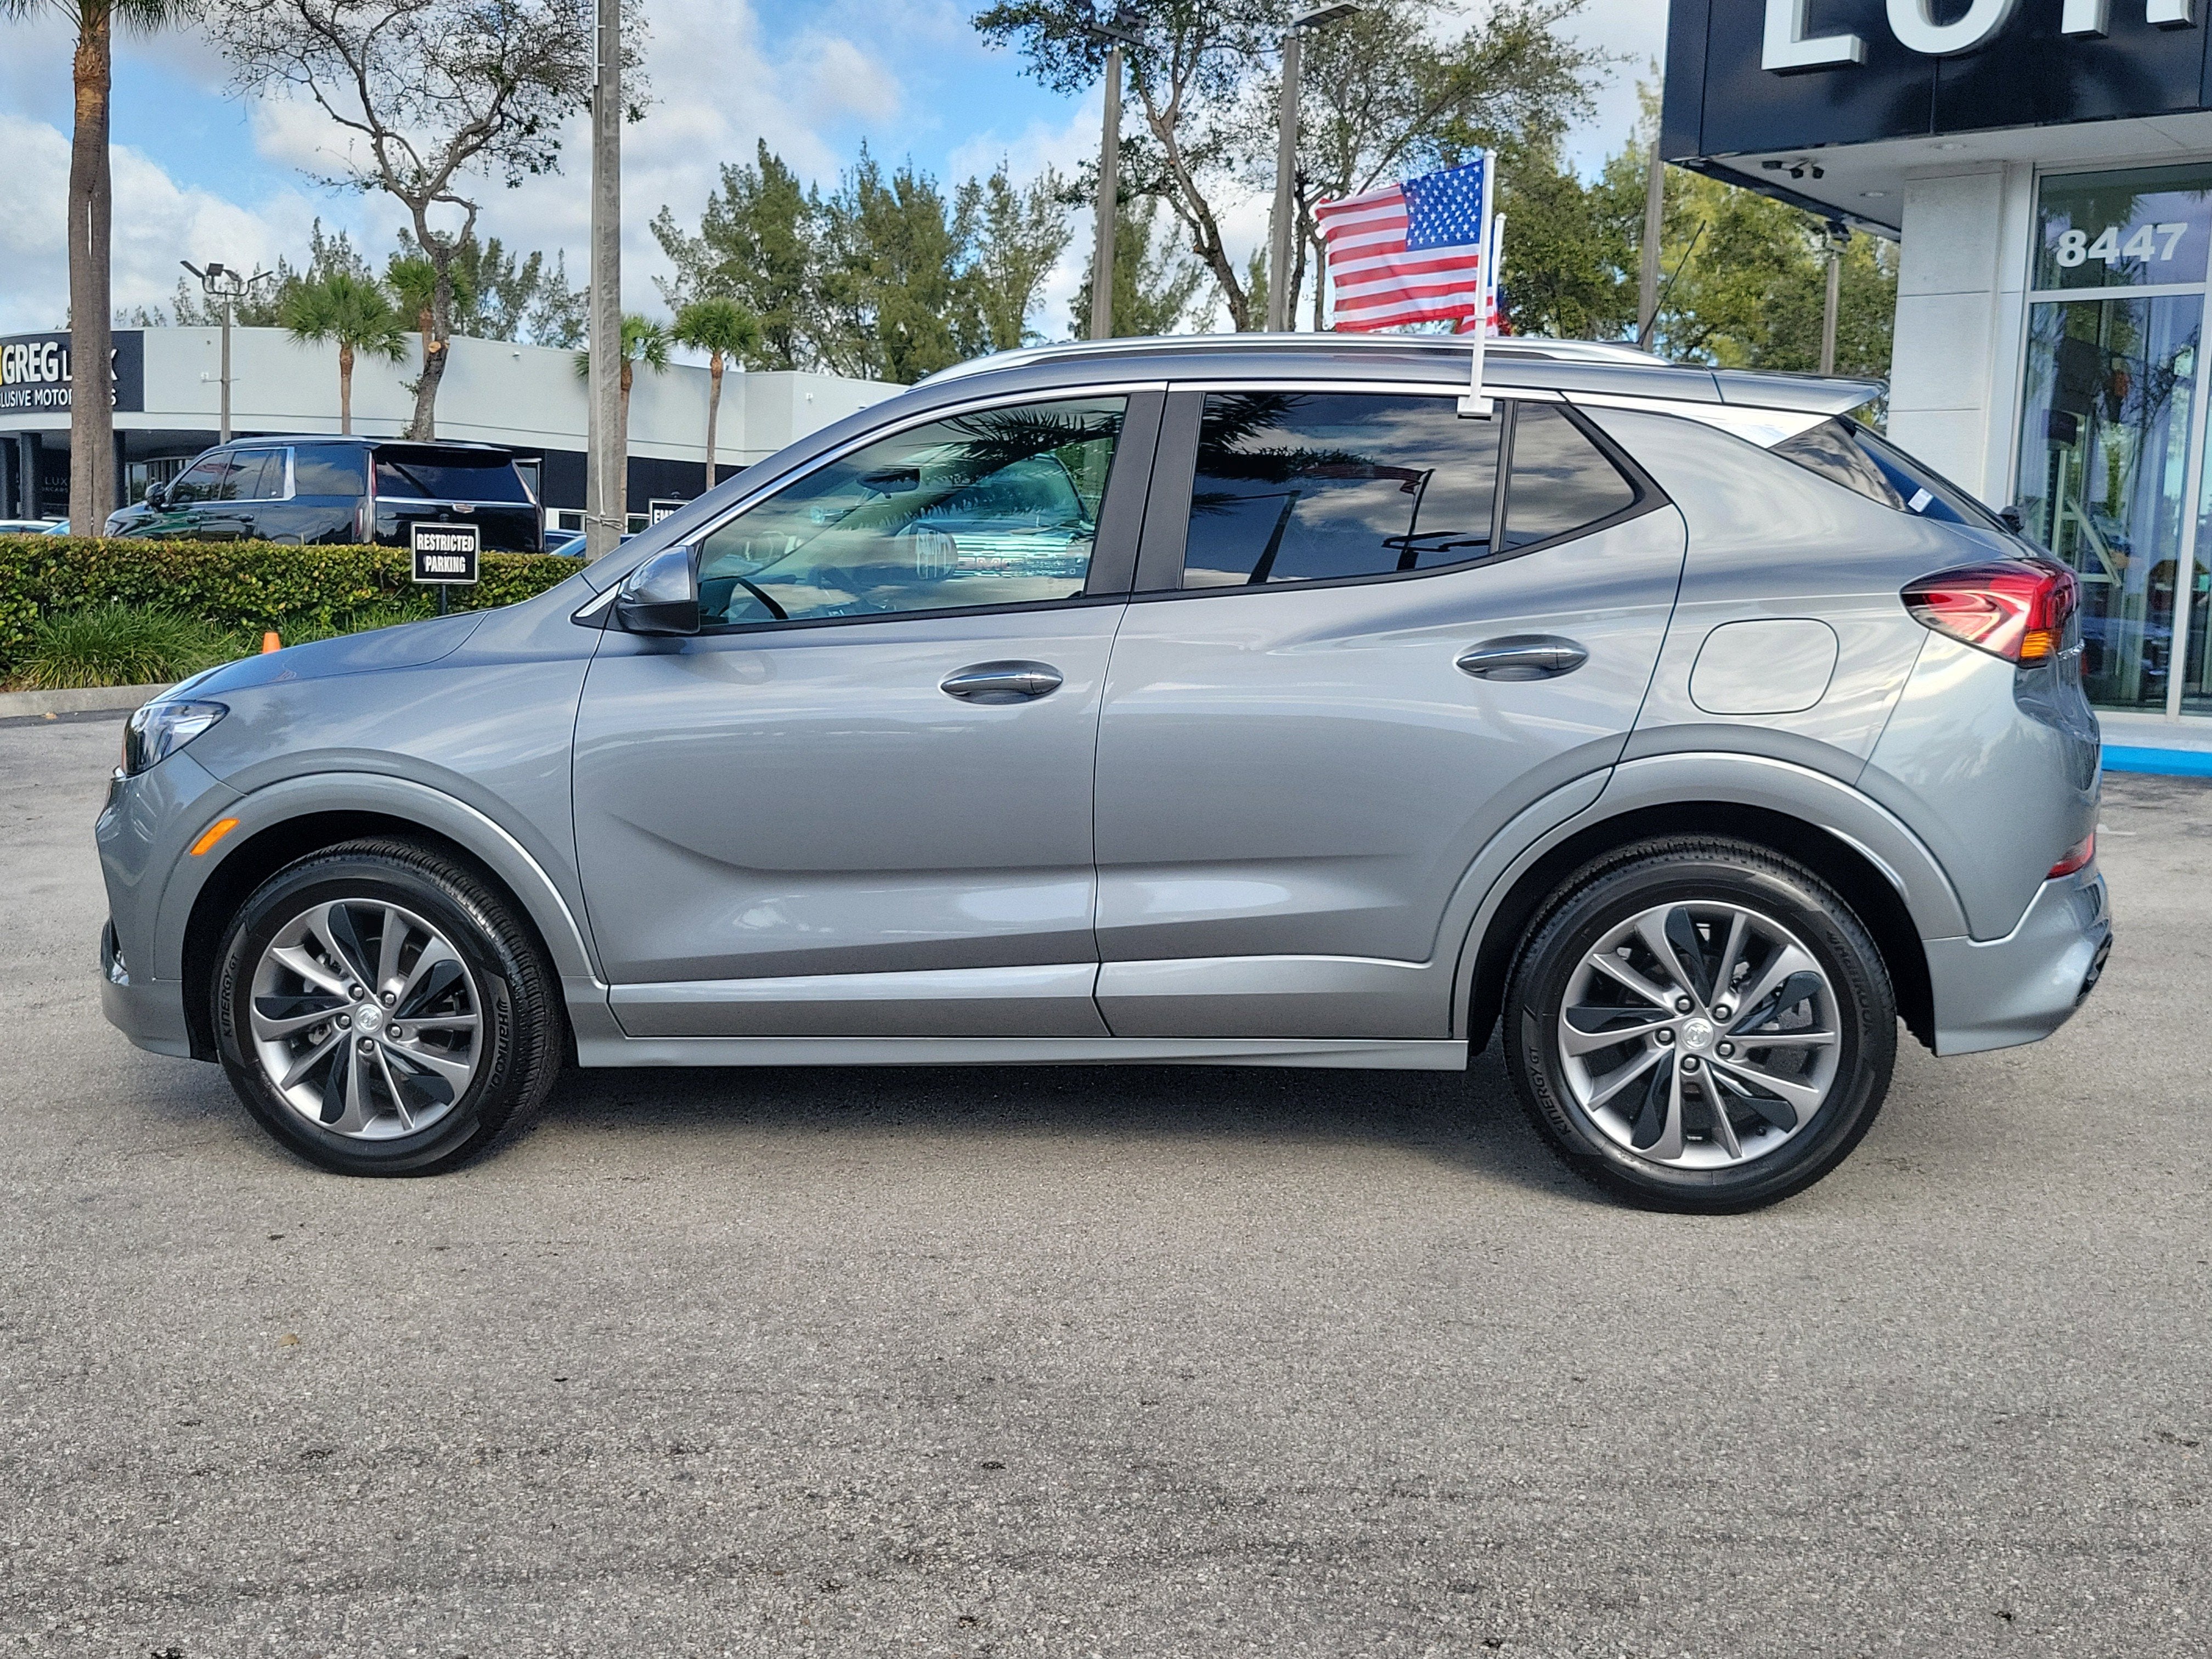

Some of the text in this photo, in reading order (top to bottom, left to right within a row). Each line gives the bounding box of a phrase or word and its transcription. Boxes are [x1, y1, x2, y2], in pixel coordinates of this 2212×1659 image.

[2056, 222, 2187, 268] 8447
[0, 341, 59, 385] GREG
[0, 390, 32, 408] LUSIVE
[416, 533, 475, 552] RESTRICTED
[425, 555, 466, 573] PARKING
[1528, 1045, 1539, 1064] GT
